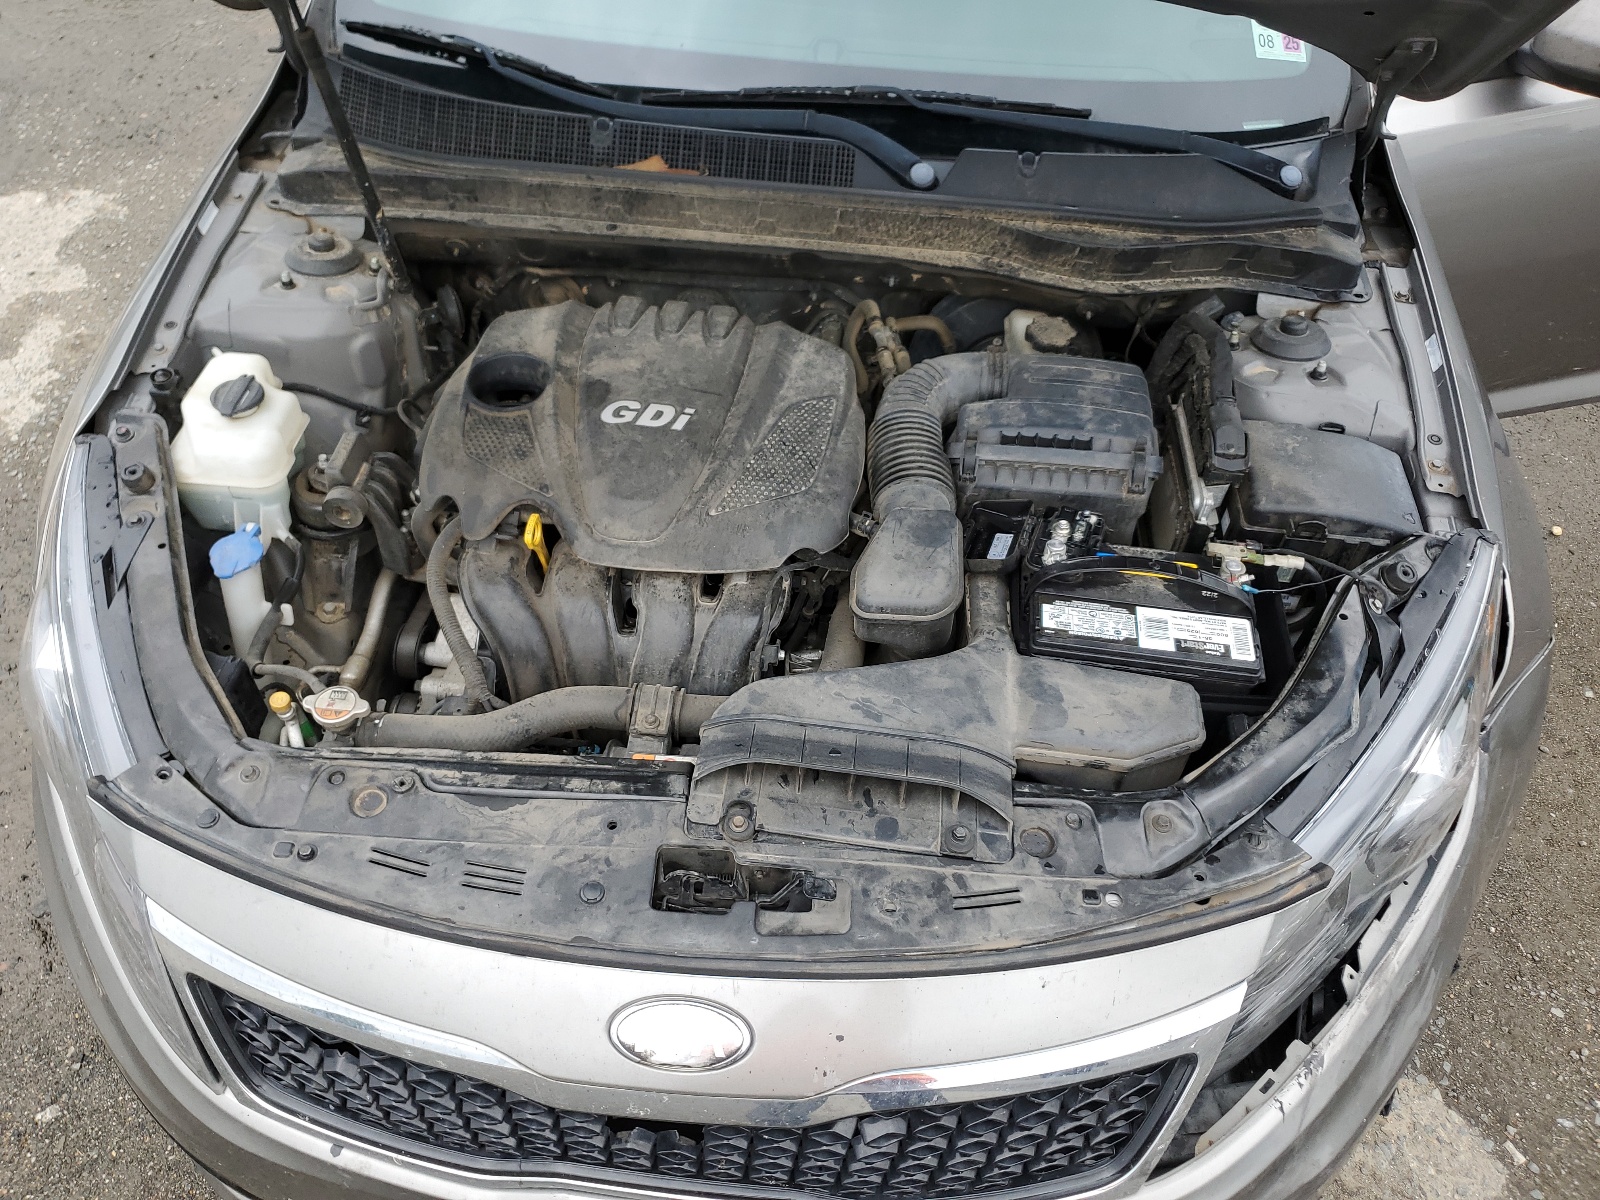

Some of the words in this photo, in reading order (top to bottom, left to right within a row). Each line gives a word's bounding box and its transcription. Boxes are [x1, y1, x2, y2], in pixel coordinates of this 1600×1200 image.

[1258, 33, 1275, 49] 08
[1283, 35, 1300, 51] 25
[600, 400, 697, 431] GDi
[1200, 590, 1219, 599] 2/22
[1180, 639, 1225, 653] EverStart
